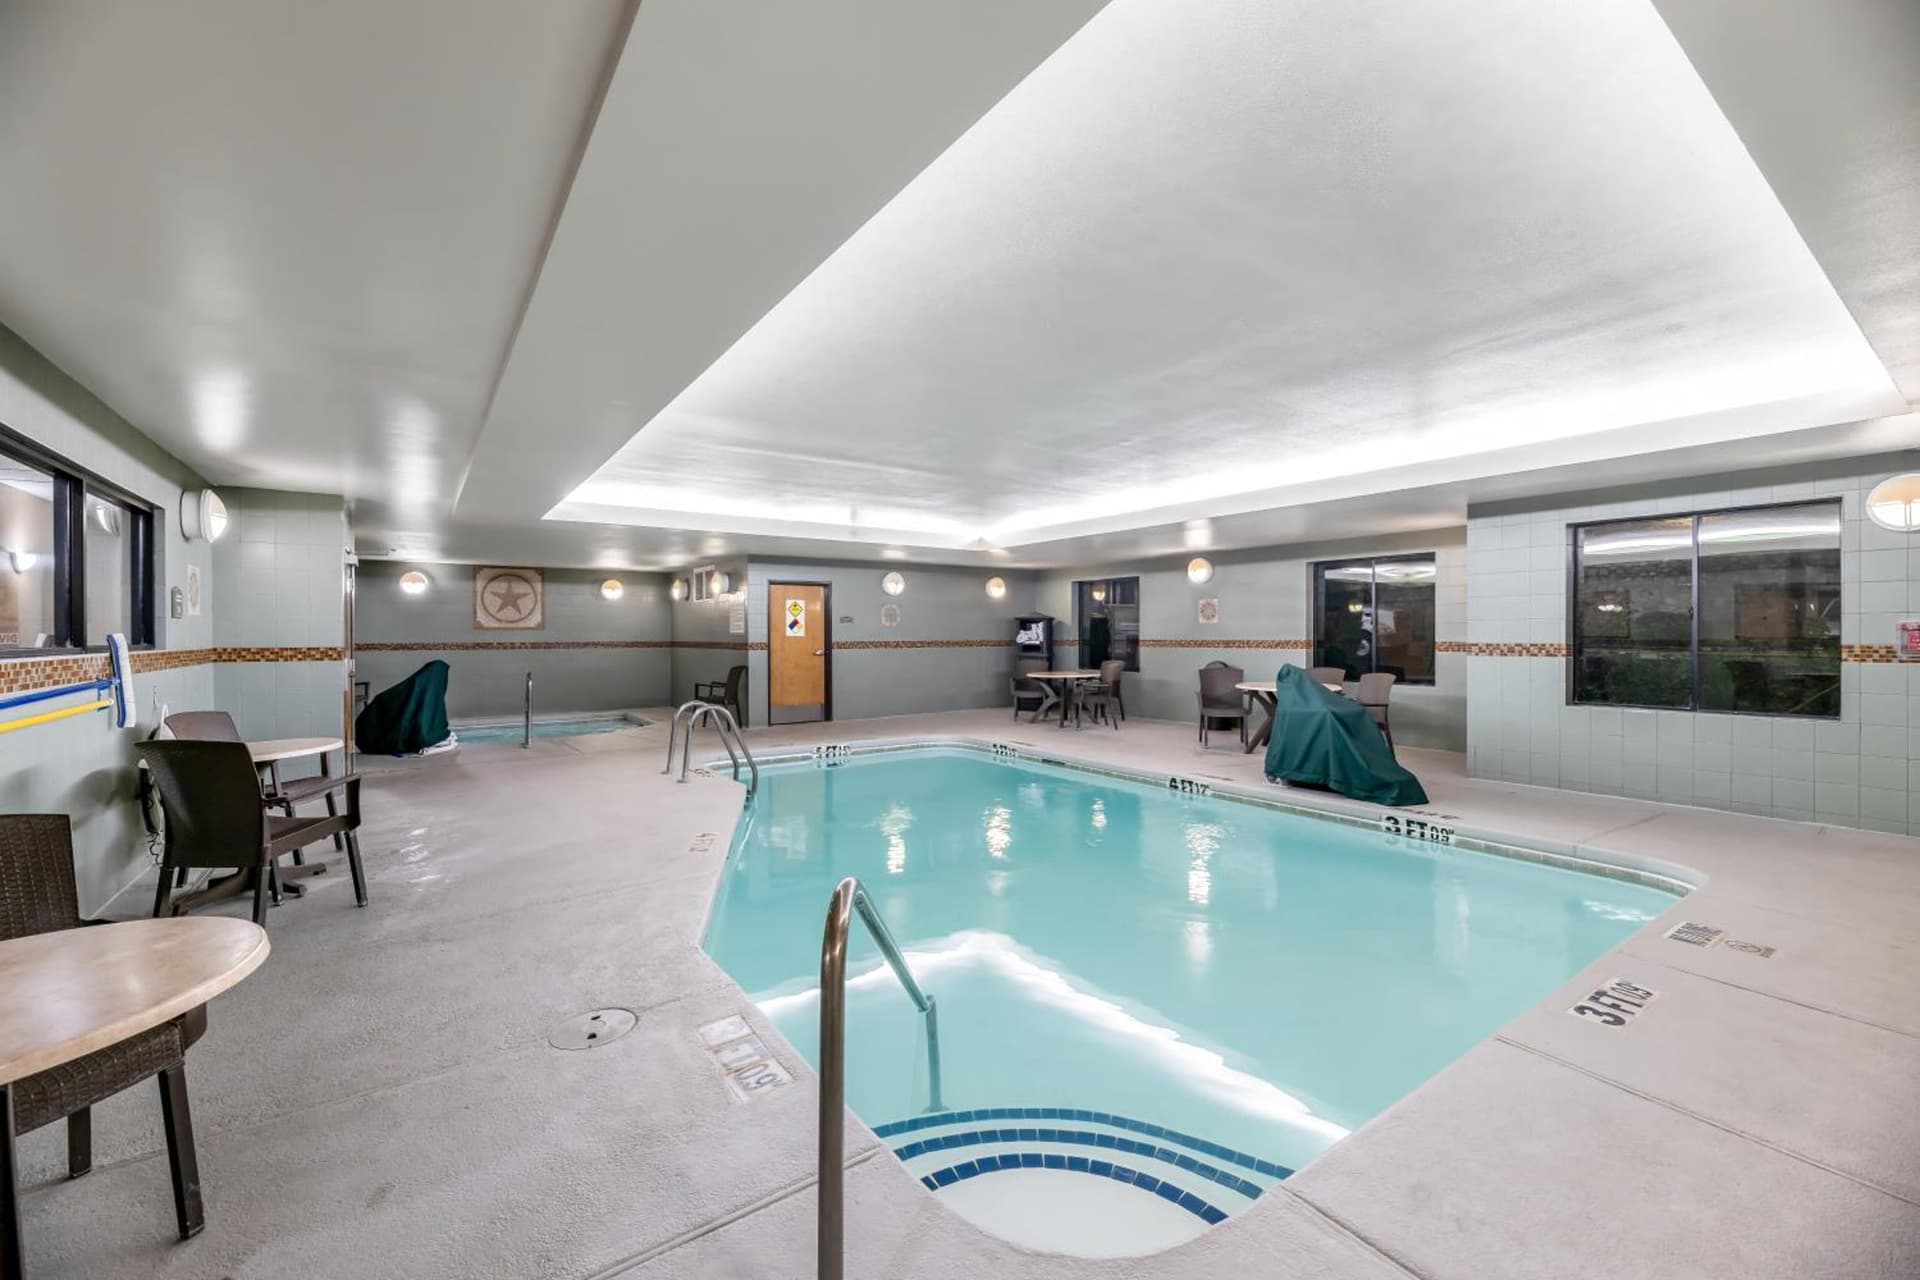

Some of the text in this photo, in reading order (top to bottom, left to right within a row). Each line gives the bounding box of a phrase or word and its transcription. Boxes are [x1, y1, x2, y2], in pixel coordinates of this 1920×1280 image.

[1181, 779, 1194, 793] FT
[1384, 816, 1402, 835] 3
[1406, 819, 1428, 840] FT
[1587, 989, 1644, 1015] FT
[1573, 1004, 1626, 1026] 3
